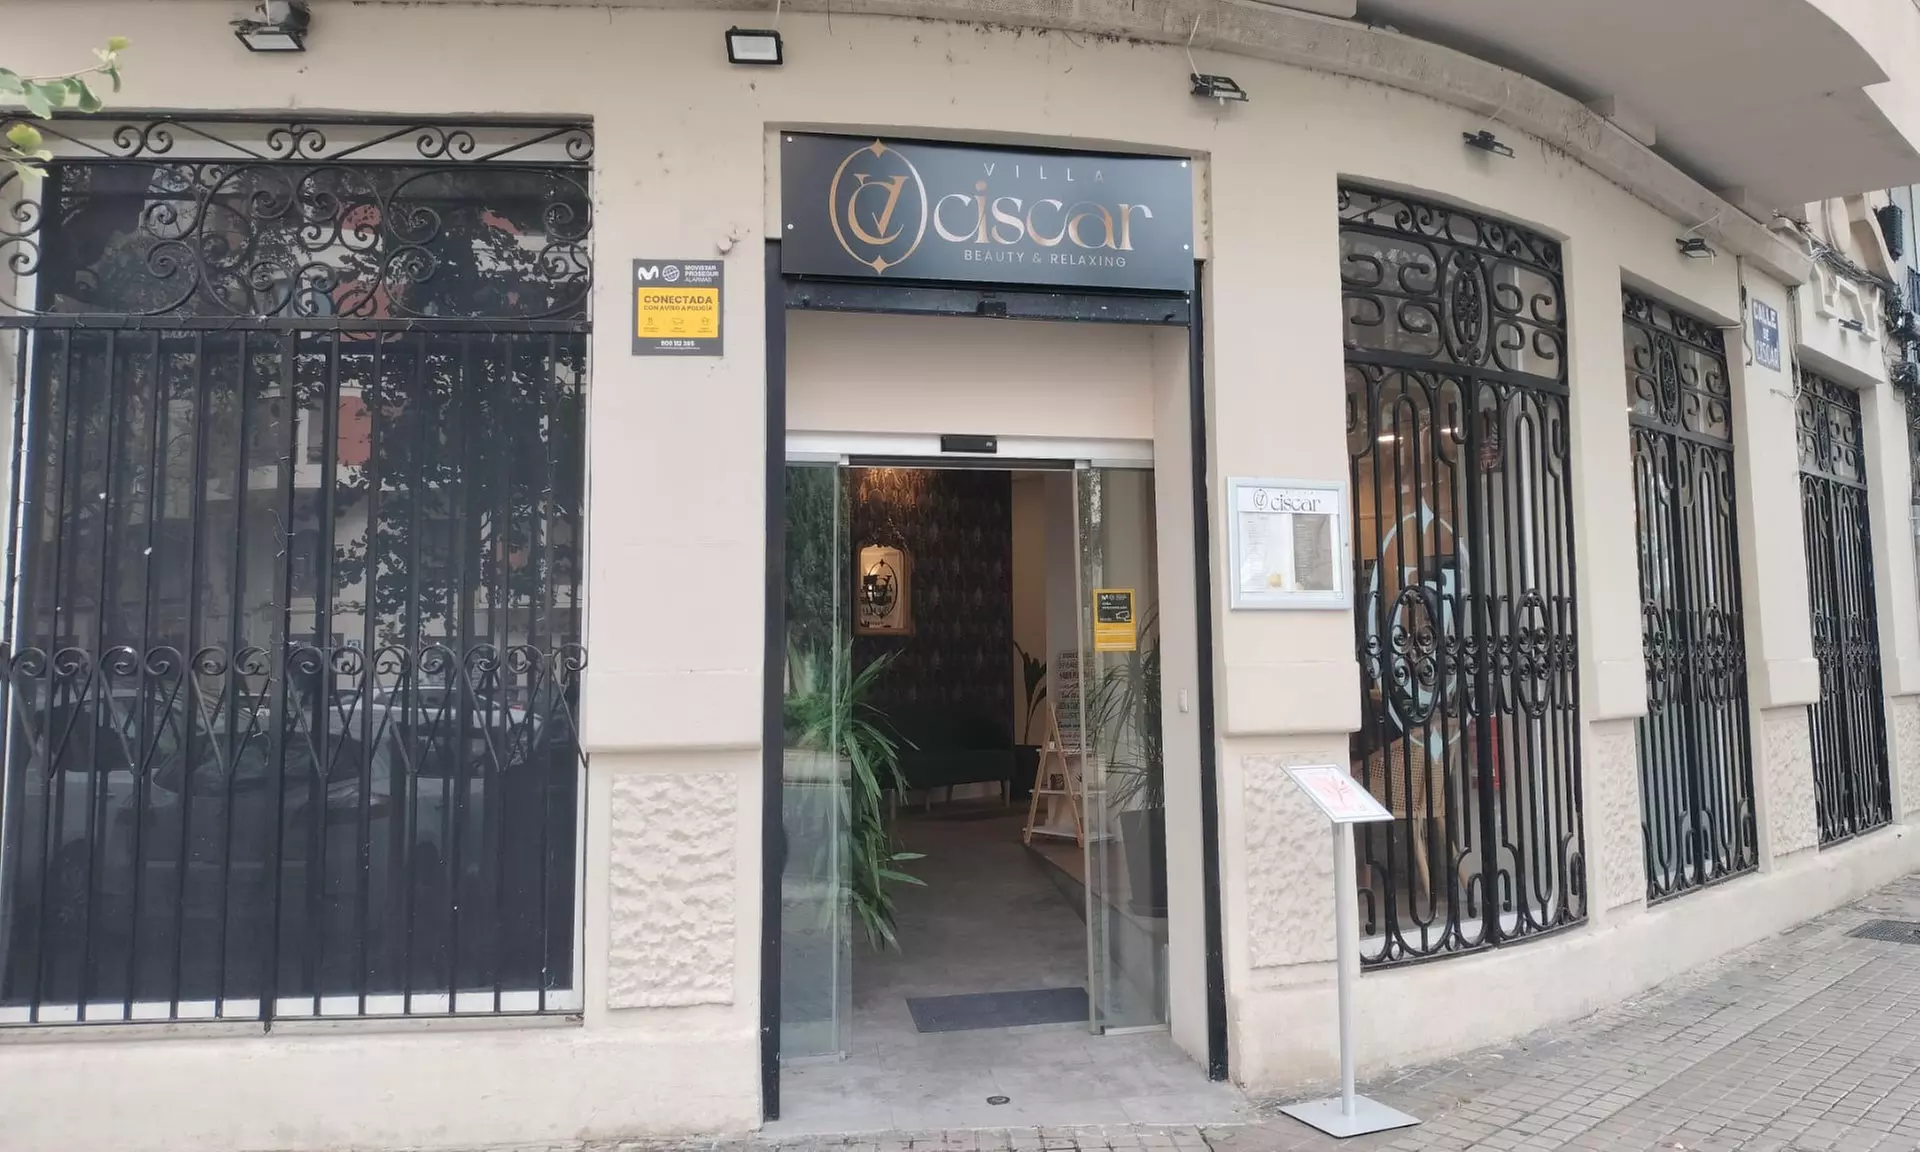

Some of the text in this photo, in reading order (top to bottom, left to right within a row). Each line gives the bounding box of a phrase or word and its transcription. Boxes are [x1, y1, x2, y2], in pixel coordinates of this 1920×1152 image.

[983, 161, 1105, 184] VILLA
[933, 180, 1153, 252] ciscar
[963, 249, 1127, 268] BEAUTY & RELAXING
[643, 295, 713, 304] CONECTADA
[1753, 301, 1777, 330] CALLE
[1270, 494, 1321, 512] ciscar
